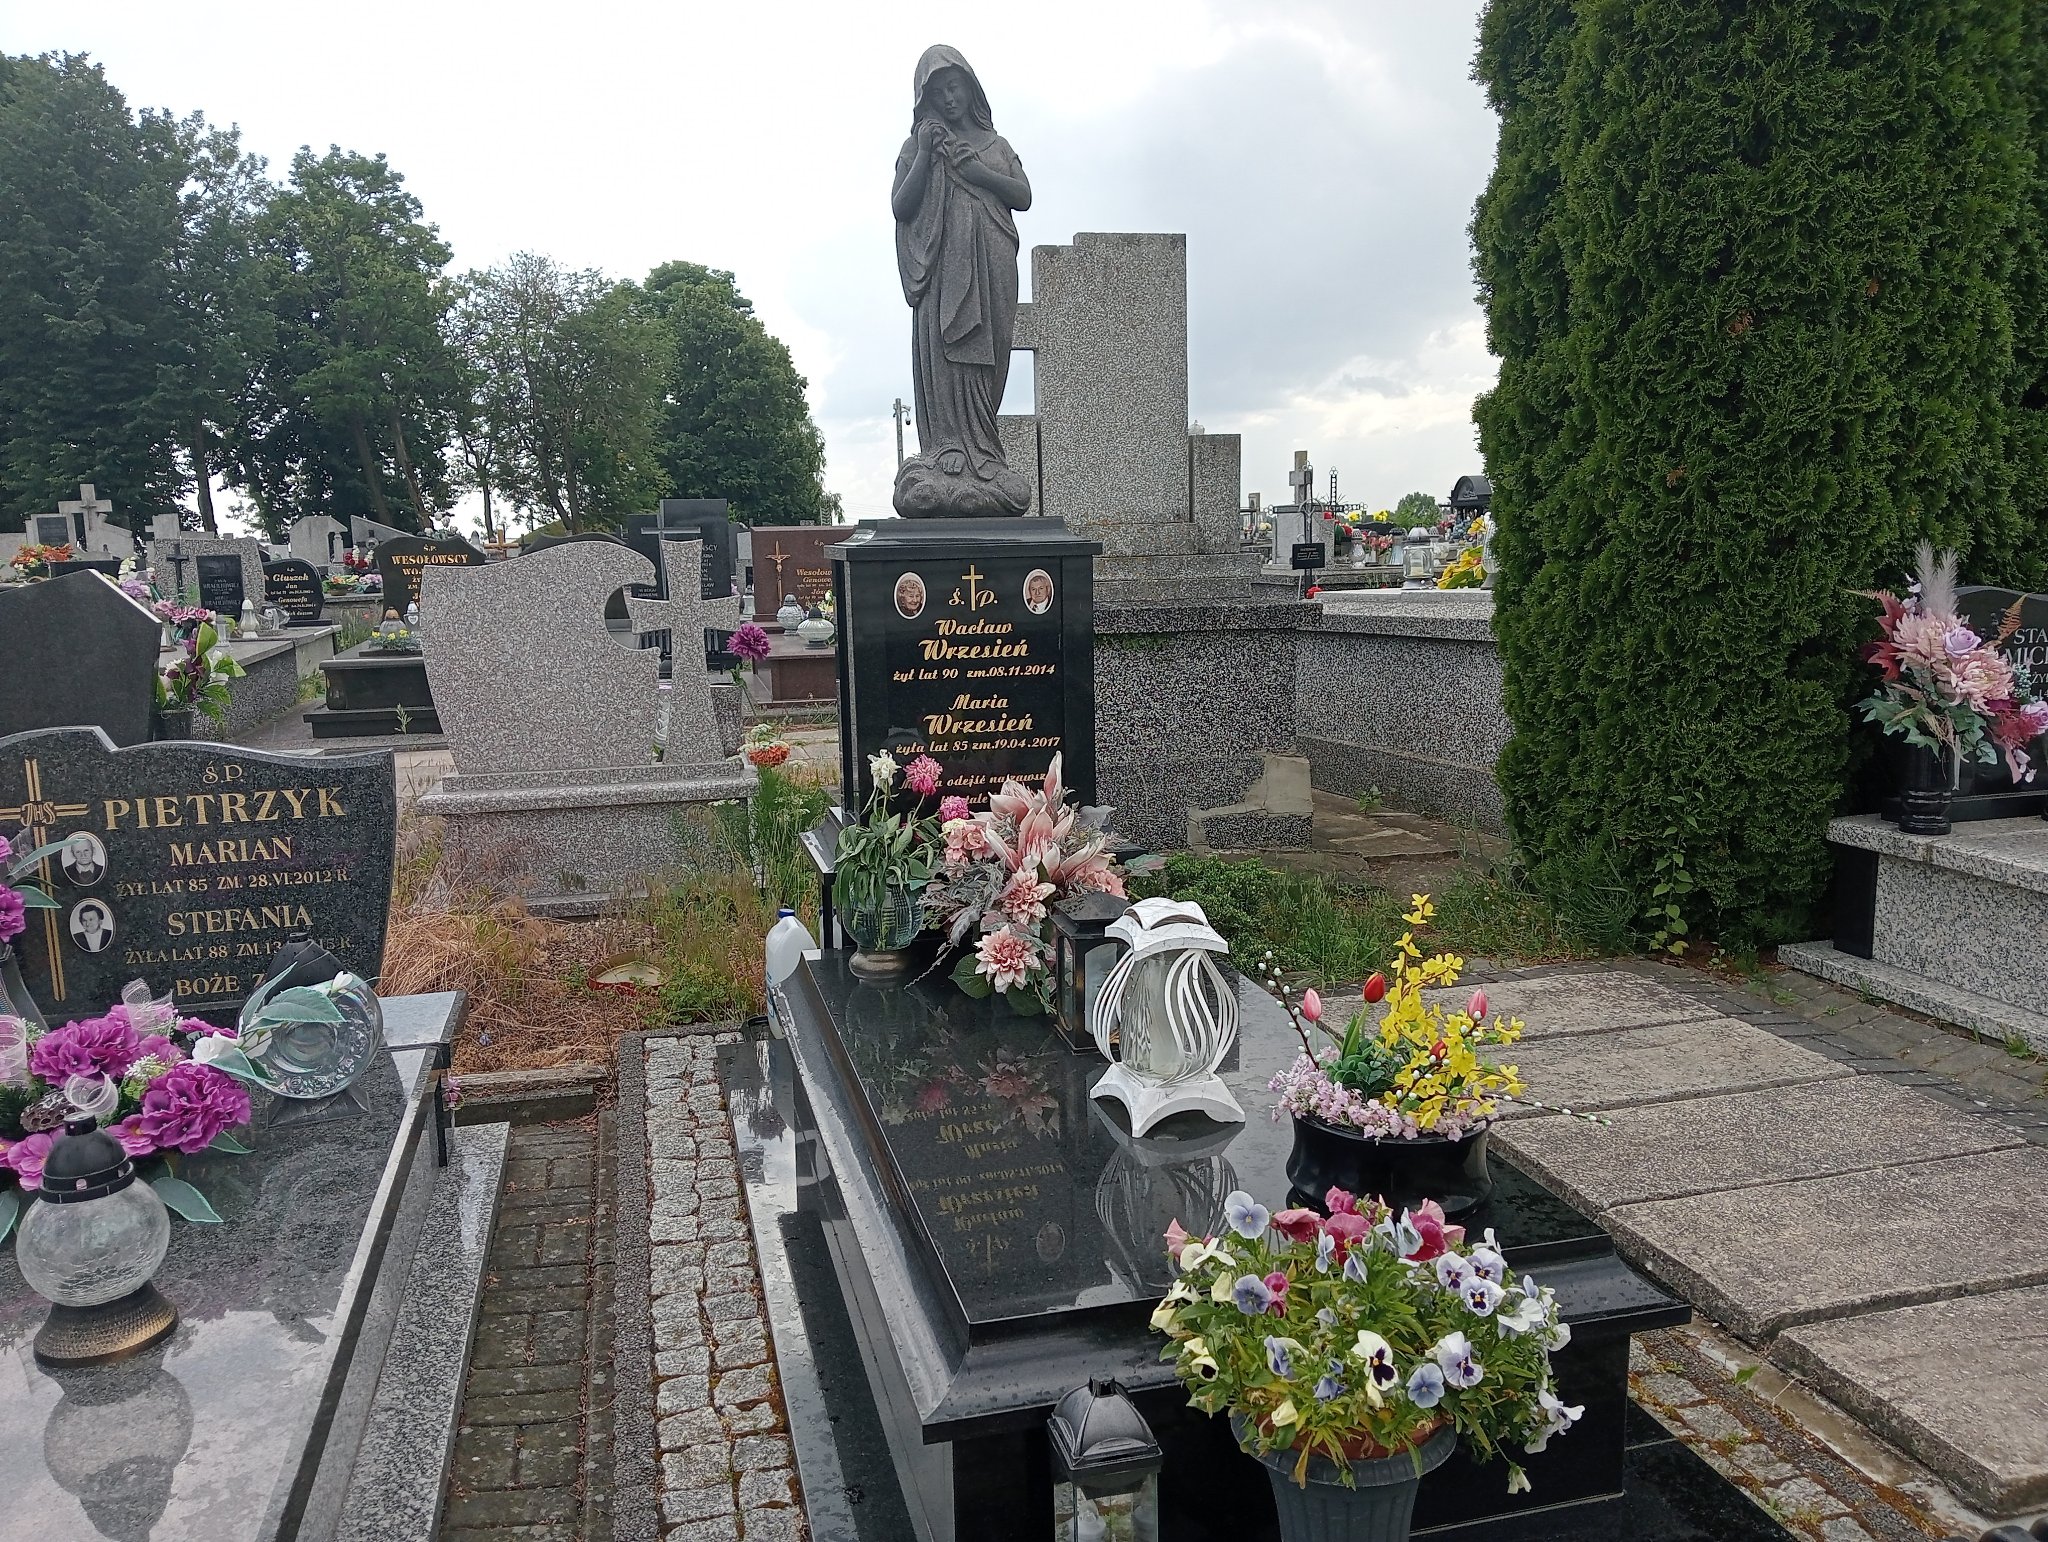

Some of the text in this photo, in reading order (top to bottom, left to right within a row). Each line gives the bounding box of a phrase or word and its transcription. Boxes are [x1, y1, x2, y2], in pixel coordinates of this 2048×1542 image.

[391, 554, 468, 565] WESOŁOWSCY
[934, 618, 1013, 636] Wacław
[918, 638, 1031, 661] Wrzesień
[893, 663, 1056, 683] żył lat 90 zm.08.11.2014
[948, 693, 1009, 711] Maria
[922, 713, 1033, 736] Wrzesień
[896, 742, 925, 756] żyła
[930, 741, 949, 753] lat
[952, 741, 968, 751] 85
[947, 774, 986, 788] odejść
[1009, 773, 1046, 782] zawsz
[103, 786, 347, 830] PIETRZYK
[168, 836, 293, 867] MARIAN
[116, 868, 352, 897] ŻYŁ LAT 85 ZM. 28.VI.2012 R.
[167, 904, 314, 936] STEFANIA
[125, 949, 169, 965] ŻYŁA
[172, 946, 203, 961] LAT
[208, 945, 229, 959] 88
[175, 972, 240, 997] BOŻE
